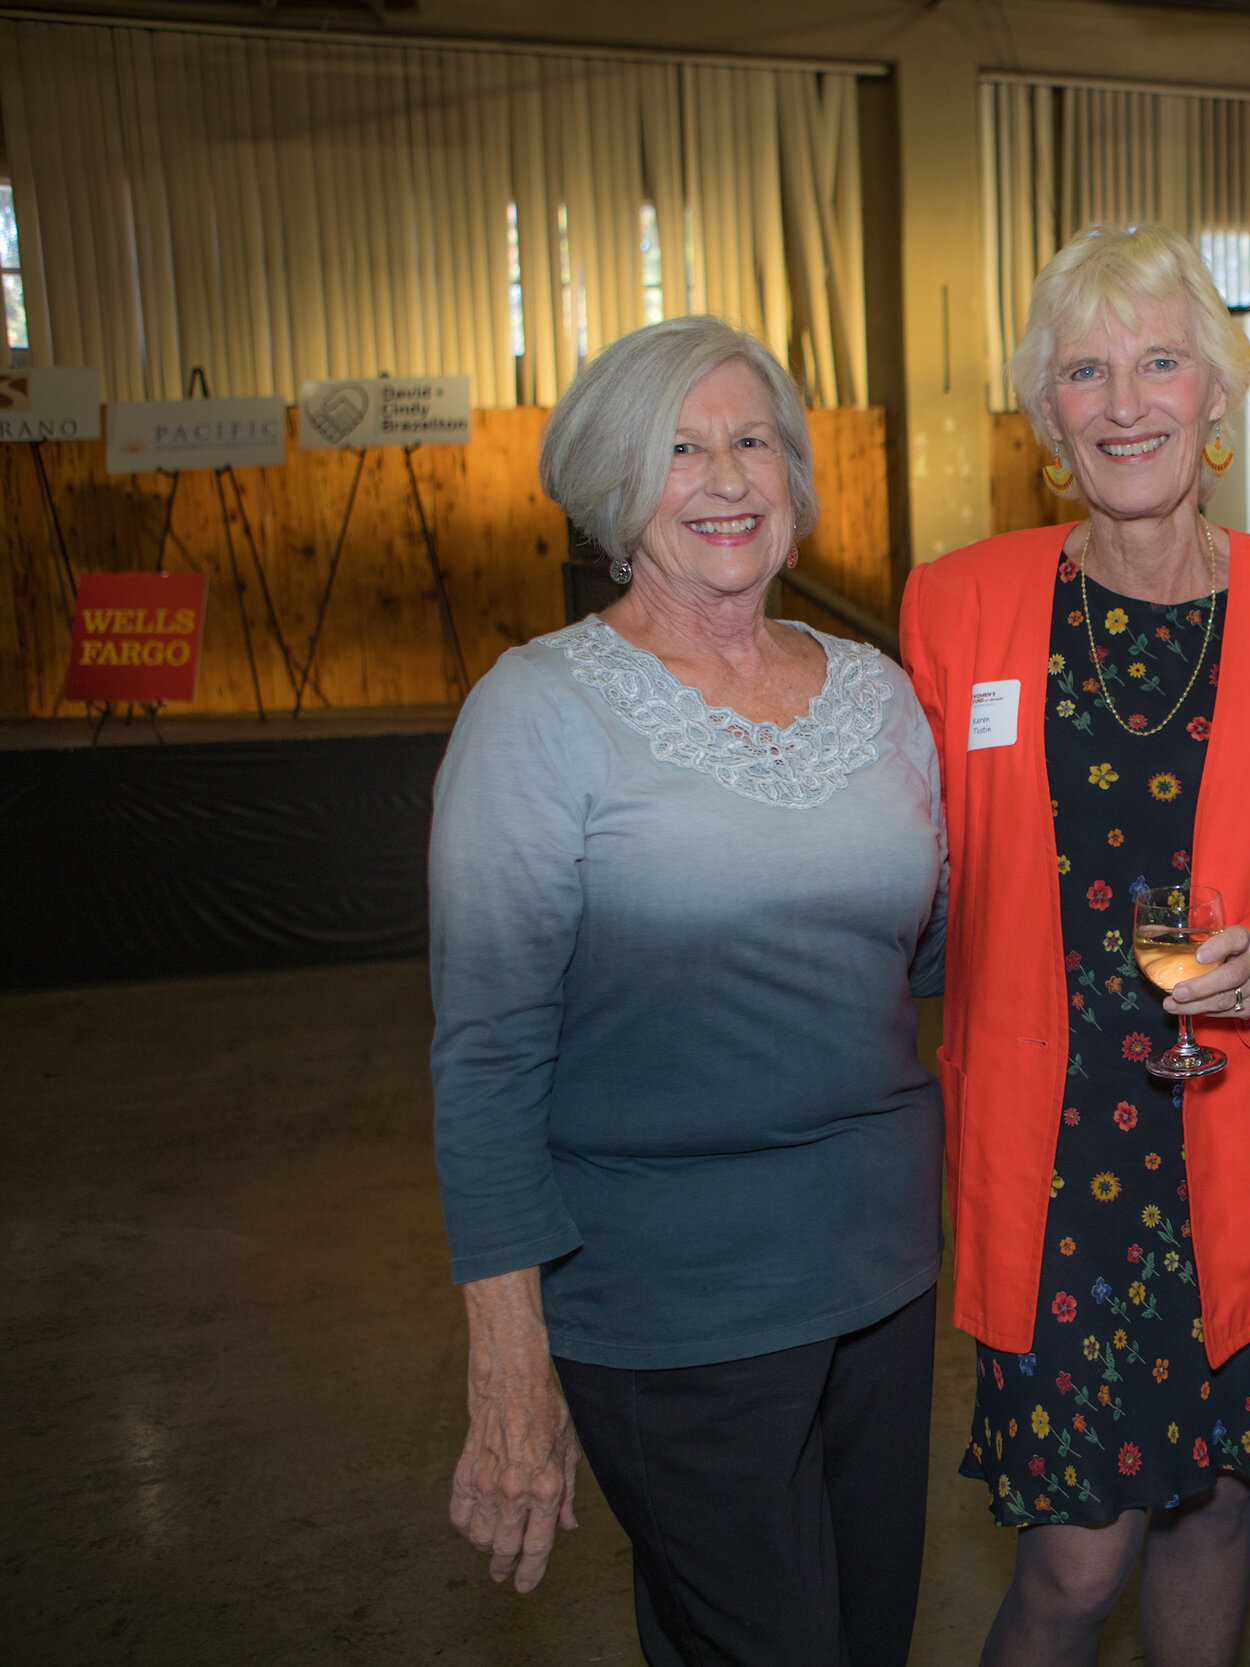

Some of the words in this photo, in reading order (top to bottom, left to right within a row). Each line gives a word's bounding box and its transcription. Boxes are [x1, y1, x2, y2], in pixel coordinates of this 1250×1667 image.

[155, 417, 279, 442] PACIFIC
[81, 608, 195, 634] WELLS
[80, 639, 191, 666] FARGO
